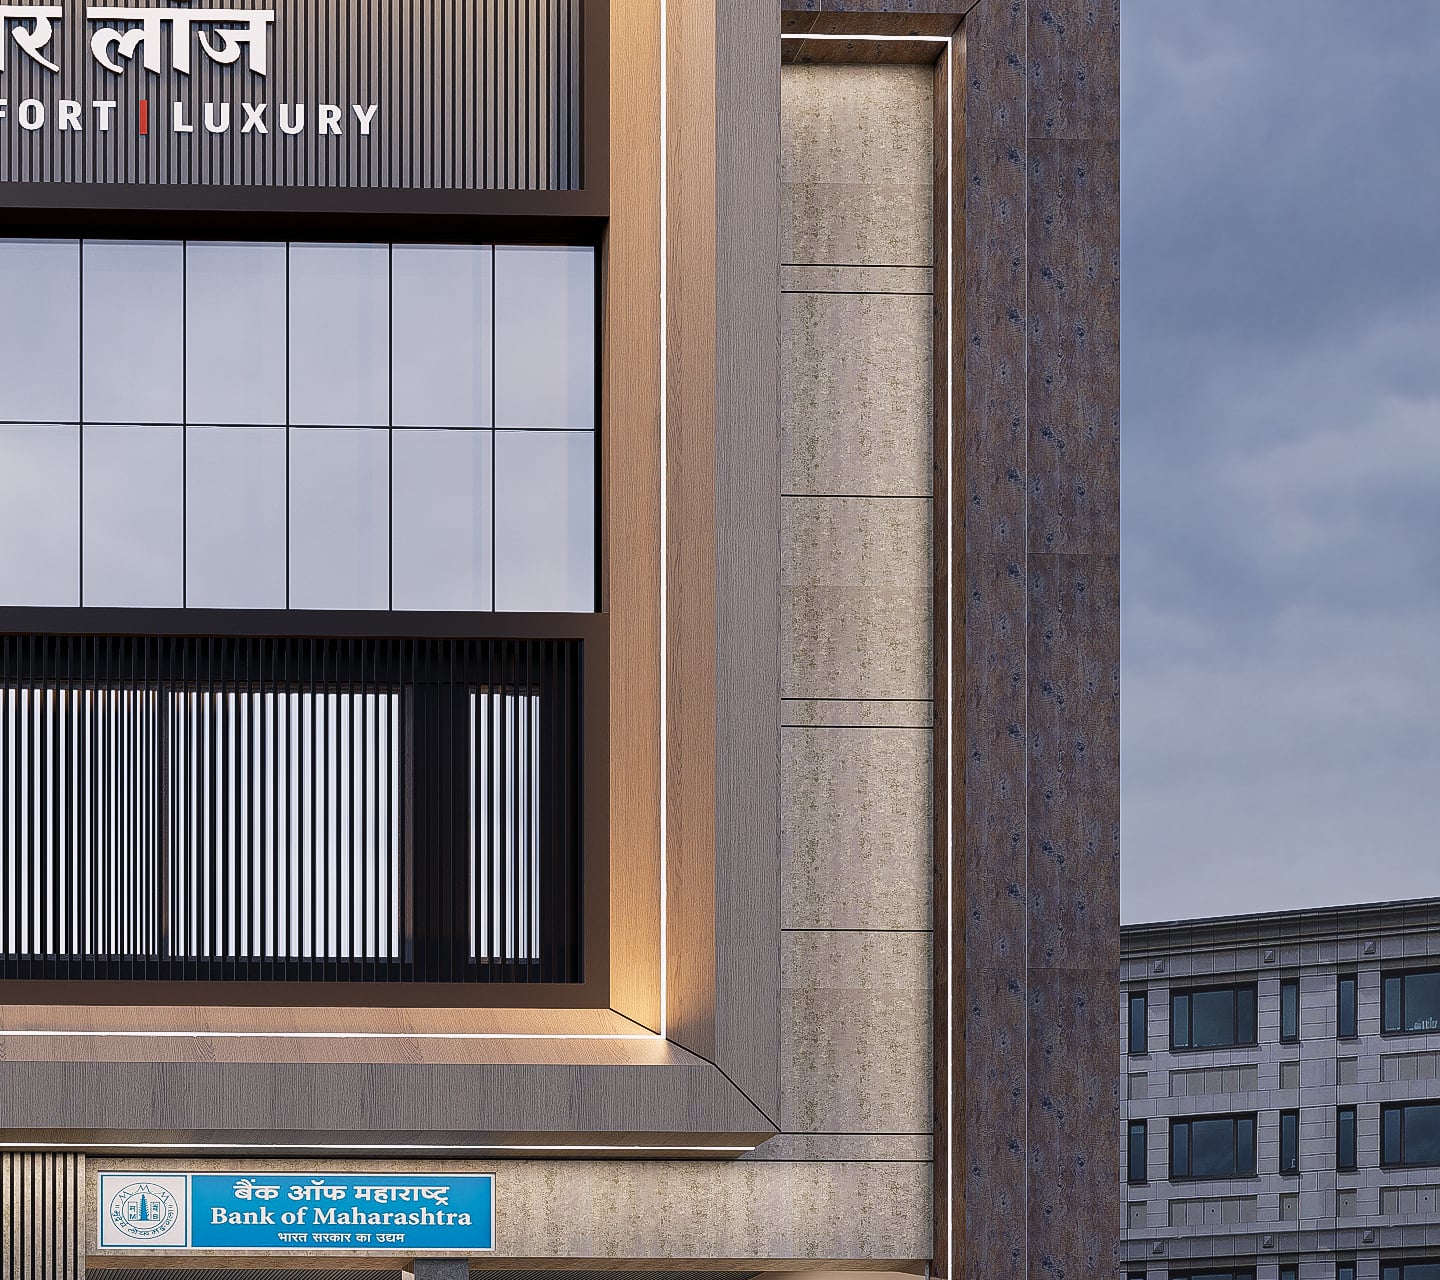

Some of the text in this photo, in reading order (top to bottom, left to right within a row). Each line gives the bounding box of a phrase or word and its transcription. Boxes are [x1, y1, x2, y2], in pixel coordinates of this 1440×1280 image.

[173, 101, 380, 137] LUXURY
[233, 1178, 450, 1206] बैंक ऑफ महाराष्ट्र
[210, 1206, 473, 1227] Bank of Maharashtra
[277, 1232, 406, 1244] भारत सरकार का उद्यम
